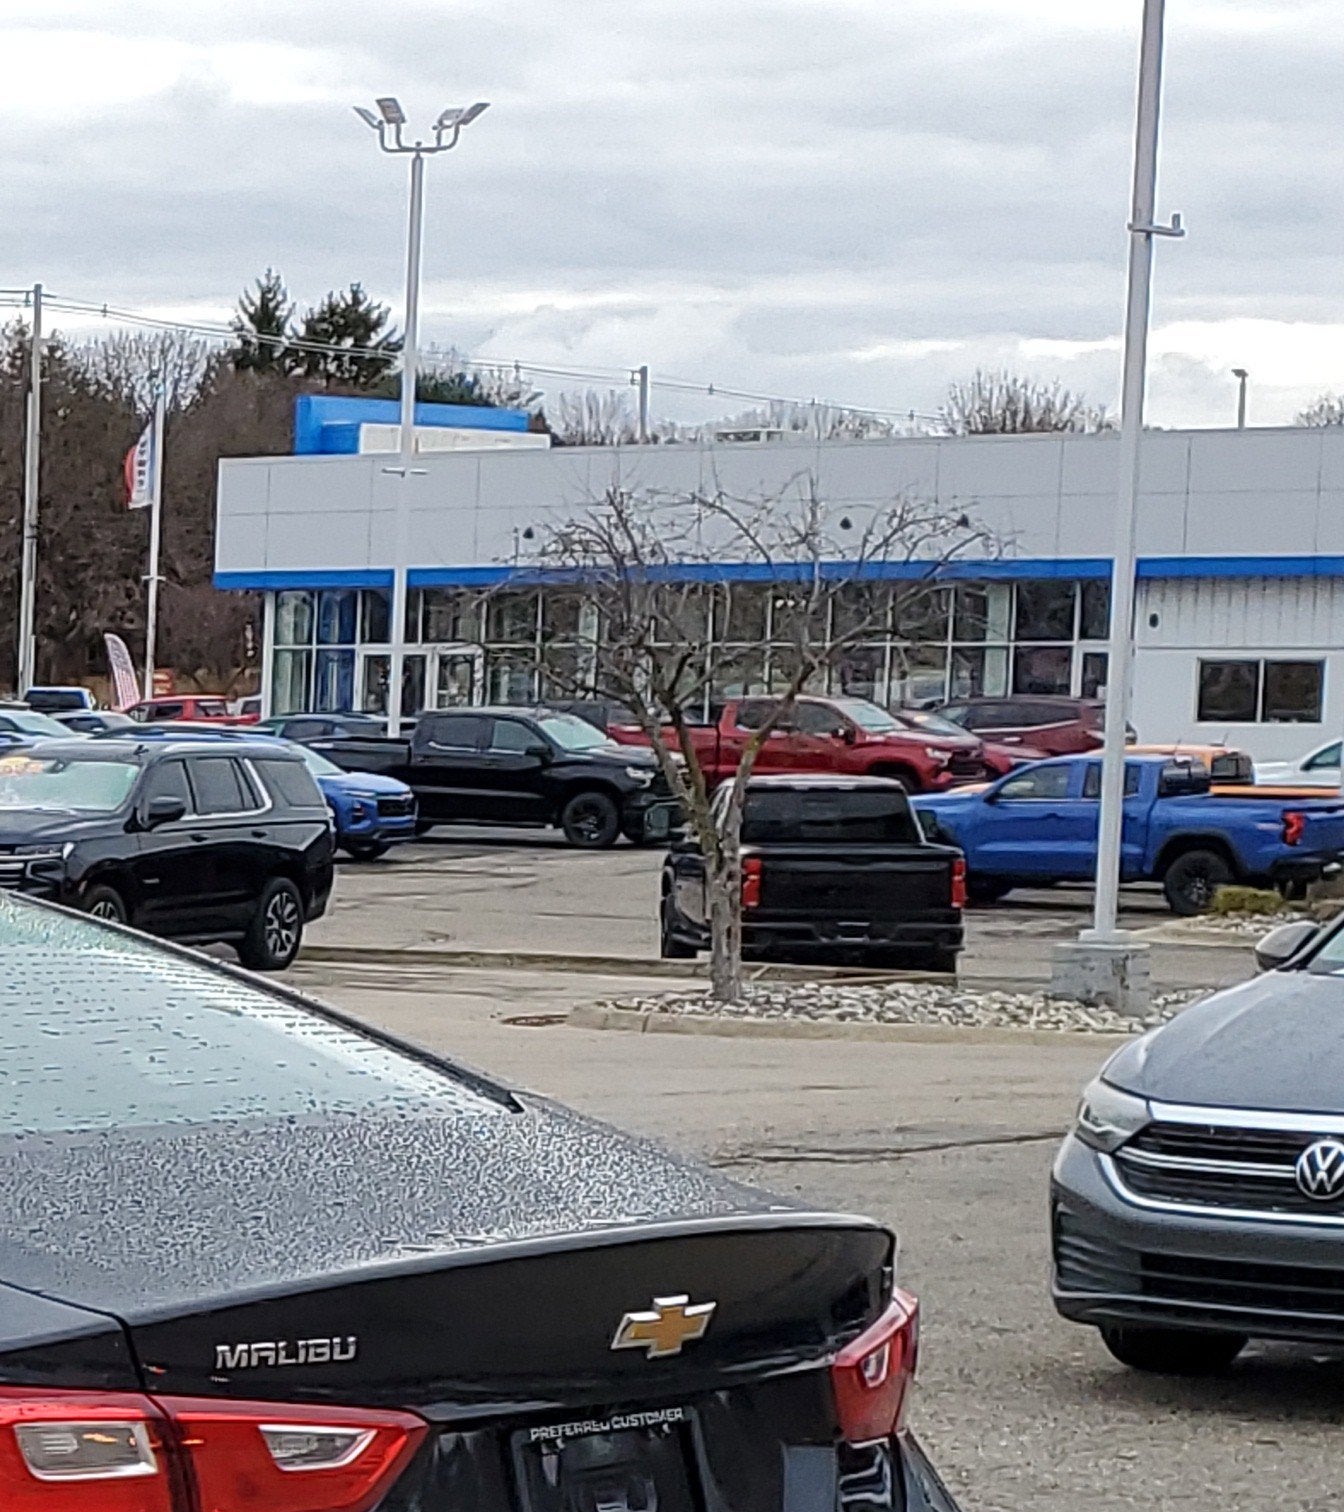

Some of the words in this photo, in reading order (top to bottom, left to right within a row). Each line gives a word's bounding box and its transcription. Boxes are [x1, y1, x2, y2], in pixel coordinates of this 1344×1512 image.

[215, 1336, 357, 1369] MALIBU
[530, 1420, 610, 1441] PREFERRED
[611, 1407, 684, 1430] CUSTOMER
